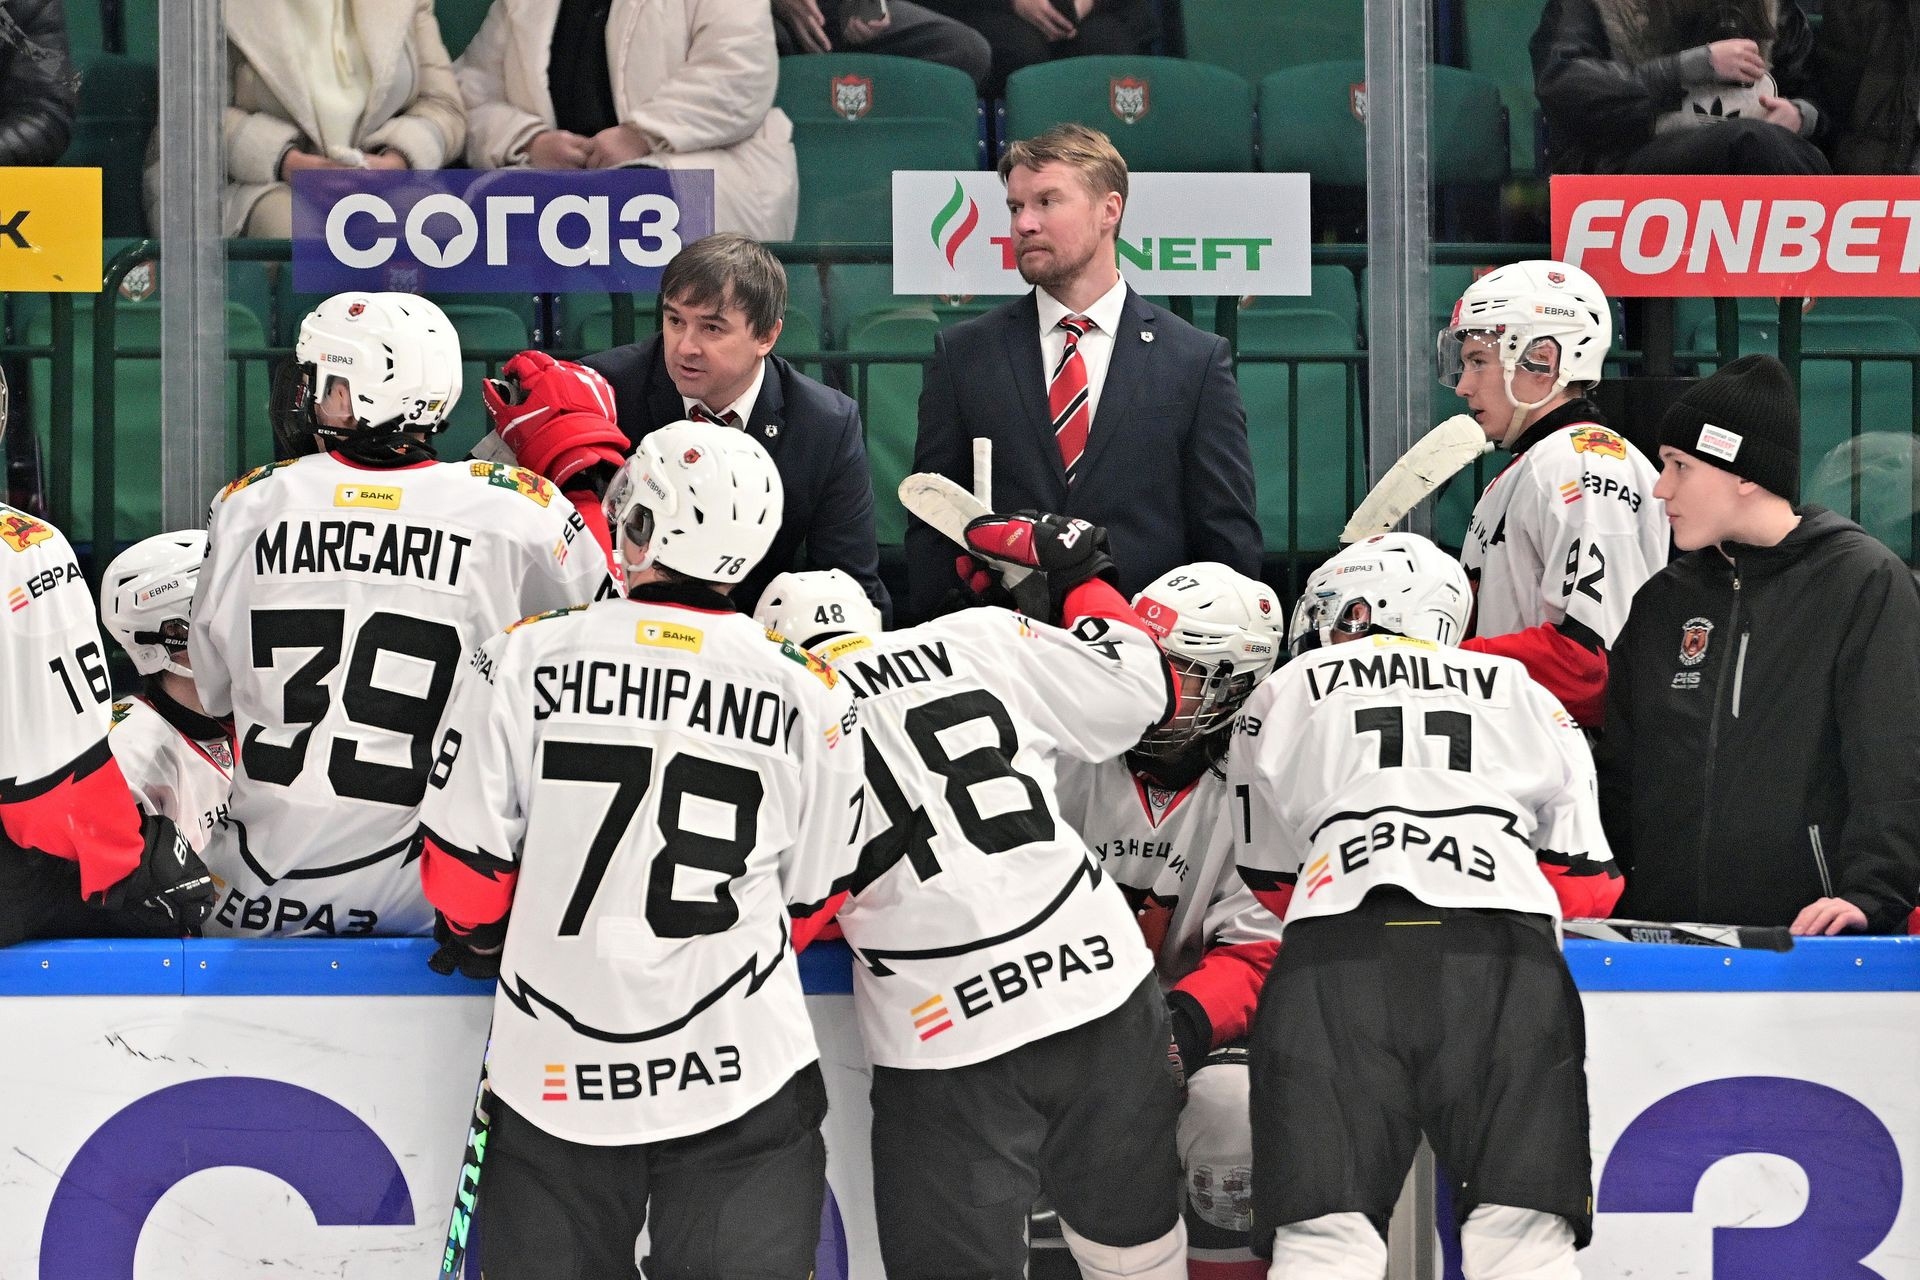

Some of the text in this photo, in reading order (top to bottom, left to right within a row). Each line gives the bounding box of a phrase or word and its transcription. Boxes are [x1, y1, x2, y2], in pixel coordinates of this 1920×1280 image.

[990, 237, 1272, 271] TNEFT
[1544, 306, 1575, 318] ЕВРАЗ
[326, 354, 353, 365] ЕВРАЗ
[360, 491, 394, 501] БАНК
[647, 479, 666, 500] ЕВРАЗ
[1581, 471, 1642, 513] ЕВРАЗ
[255, 520, 472, 586] MARGARIT
[713, 554, 746, 576] 78
[1343, 565, 1373, 574] ЕВРАЗ
[1562, 537, 1606, 605] 92
[26, 562, 84, 599] ЕВРА
[149, 580, 179, 598] ЕВРАЗ
[1167, 575, 1200, 592] 87
[814, 603, 846, 625] 48
[1437, 617, 1451, 646] 11
[662, 630, 696, 643] БАНК
[1251, 644, 1271, 654] ЕВРАЗ
[48, 641, 111, 715] 16
[1306, 653, 1499, 701] IZMAILOV
[241, 608, 462, 808] 39
[533, 660, 799, 755] SHCHIPANOV
[1354, 706, 1472, 773] 11
[857, 689, 1056, 883] 48
[541, 740, 764, 939] 78
[1095, 838, 1189, 882] УЗНЕЦИЕ
[1339, 822, 1496, 882] ЕВРАЗ
[215, 887, 378, 935] ЕВРАЗ
[953, 935, 1115, 1019] ЕВРАЗ
[575, 1045, 742, 1101] ЕВРАЗ
